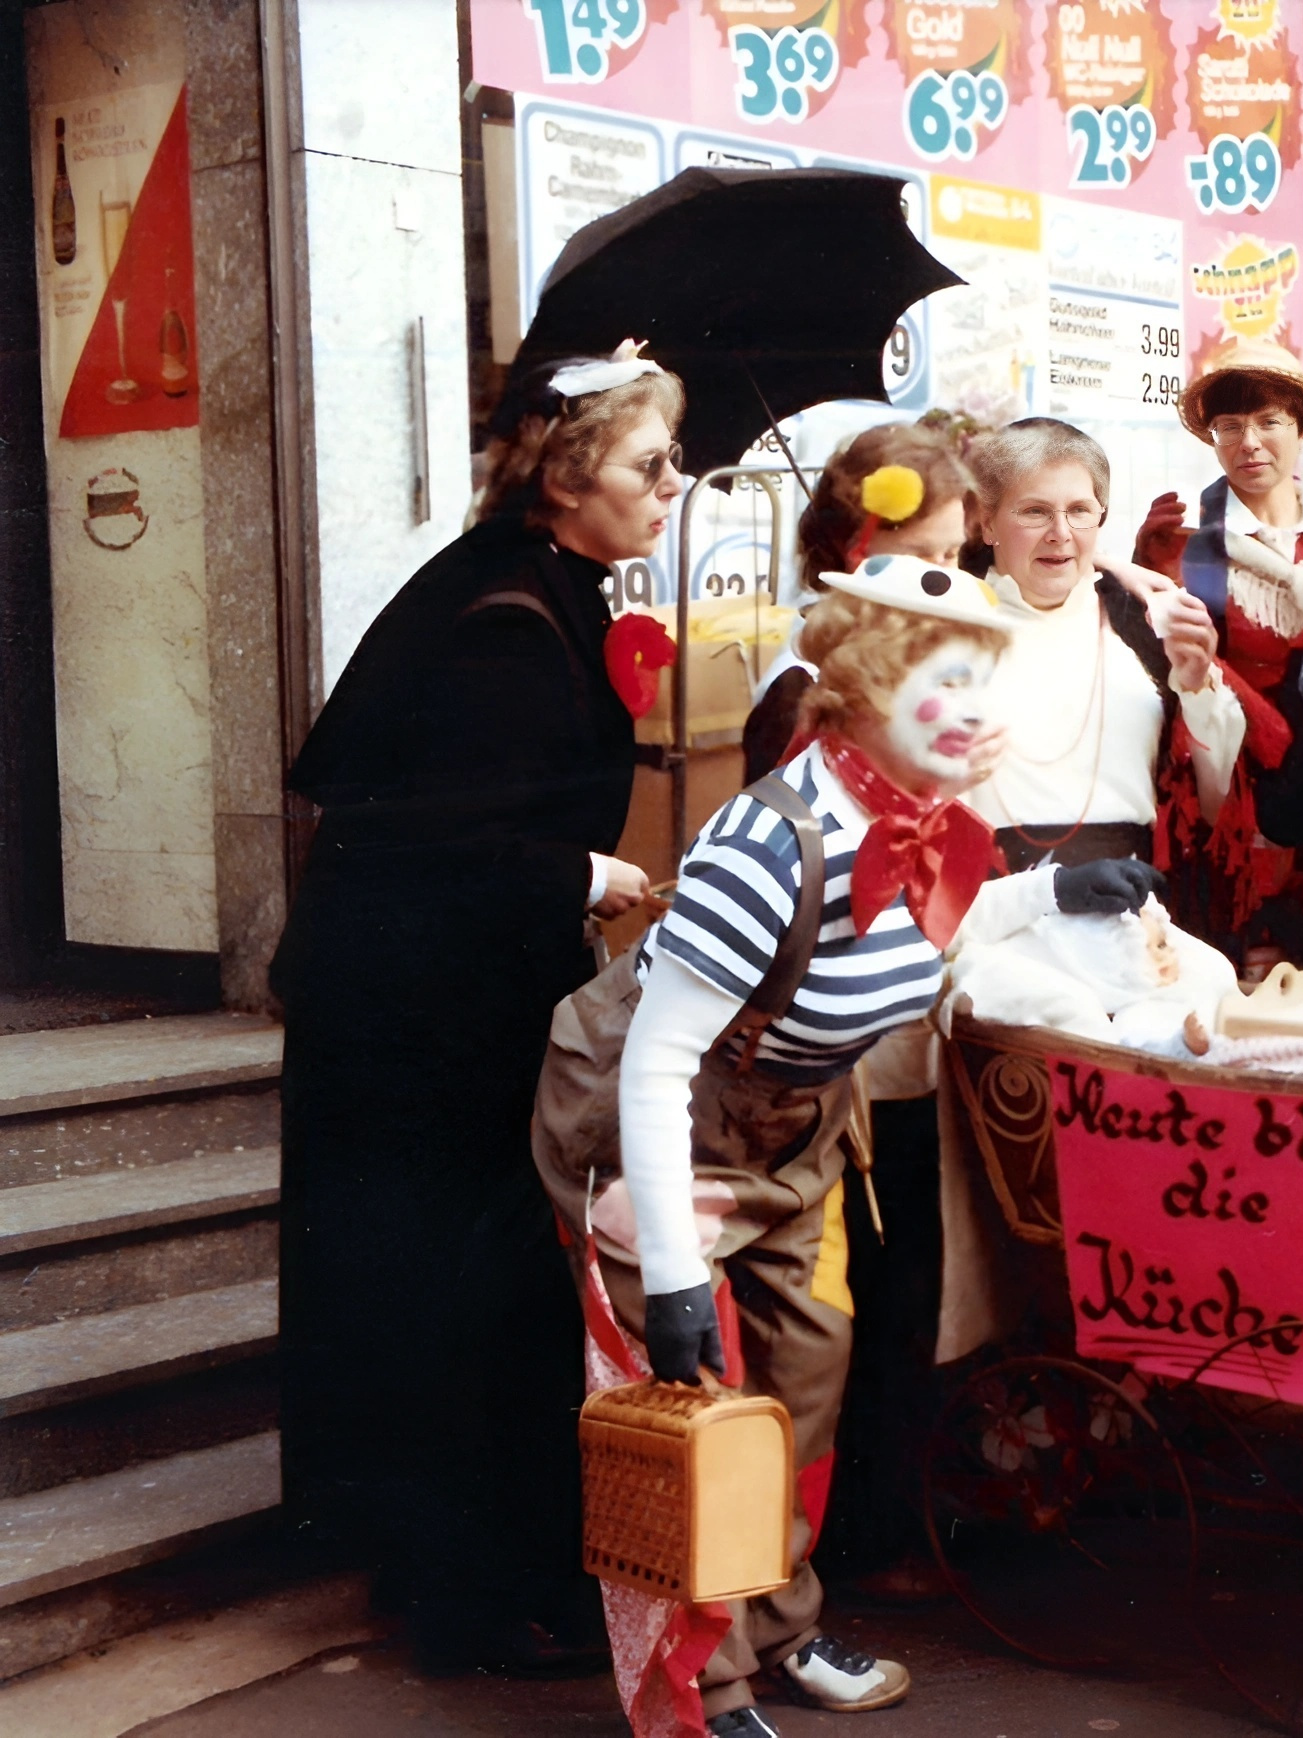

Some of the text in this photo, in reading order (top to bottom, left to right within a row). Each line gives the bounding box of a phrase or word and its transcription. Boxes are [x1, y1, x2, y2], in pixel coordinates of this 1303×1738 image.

[906, 7, 964, 43] Gold
[734, 31, 834, 117] 3.69
[908, 75, 1004, 154] 6.99
[1070, 108, 1152, 183] 2.99
[1141, 323, 1180, 358] 3.99
[1055, 1061, 1226, 1150] Heute
[1161, 1158, 1270, 1224] die
[1076, 1230, 1303, 1356] Küche
